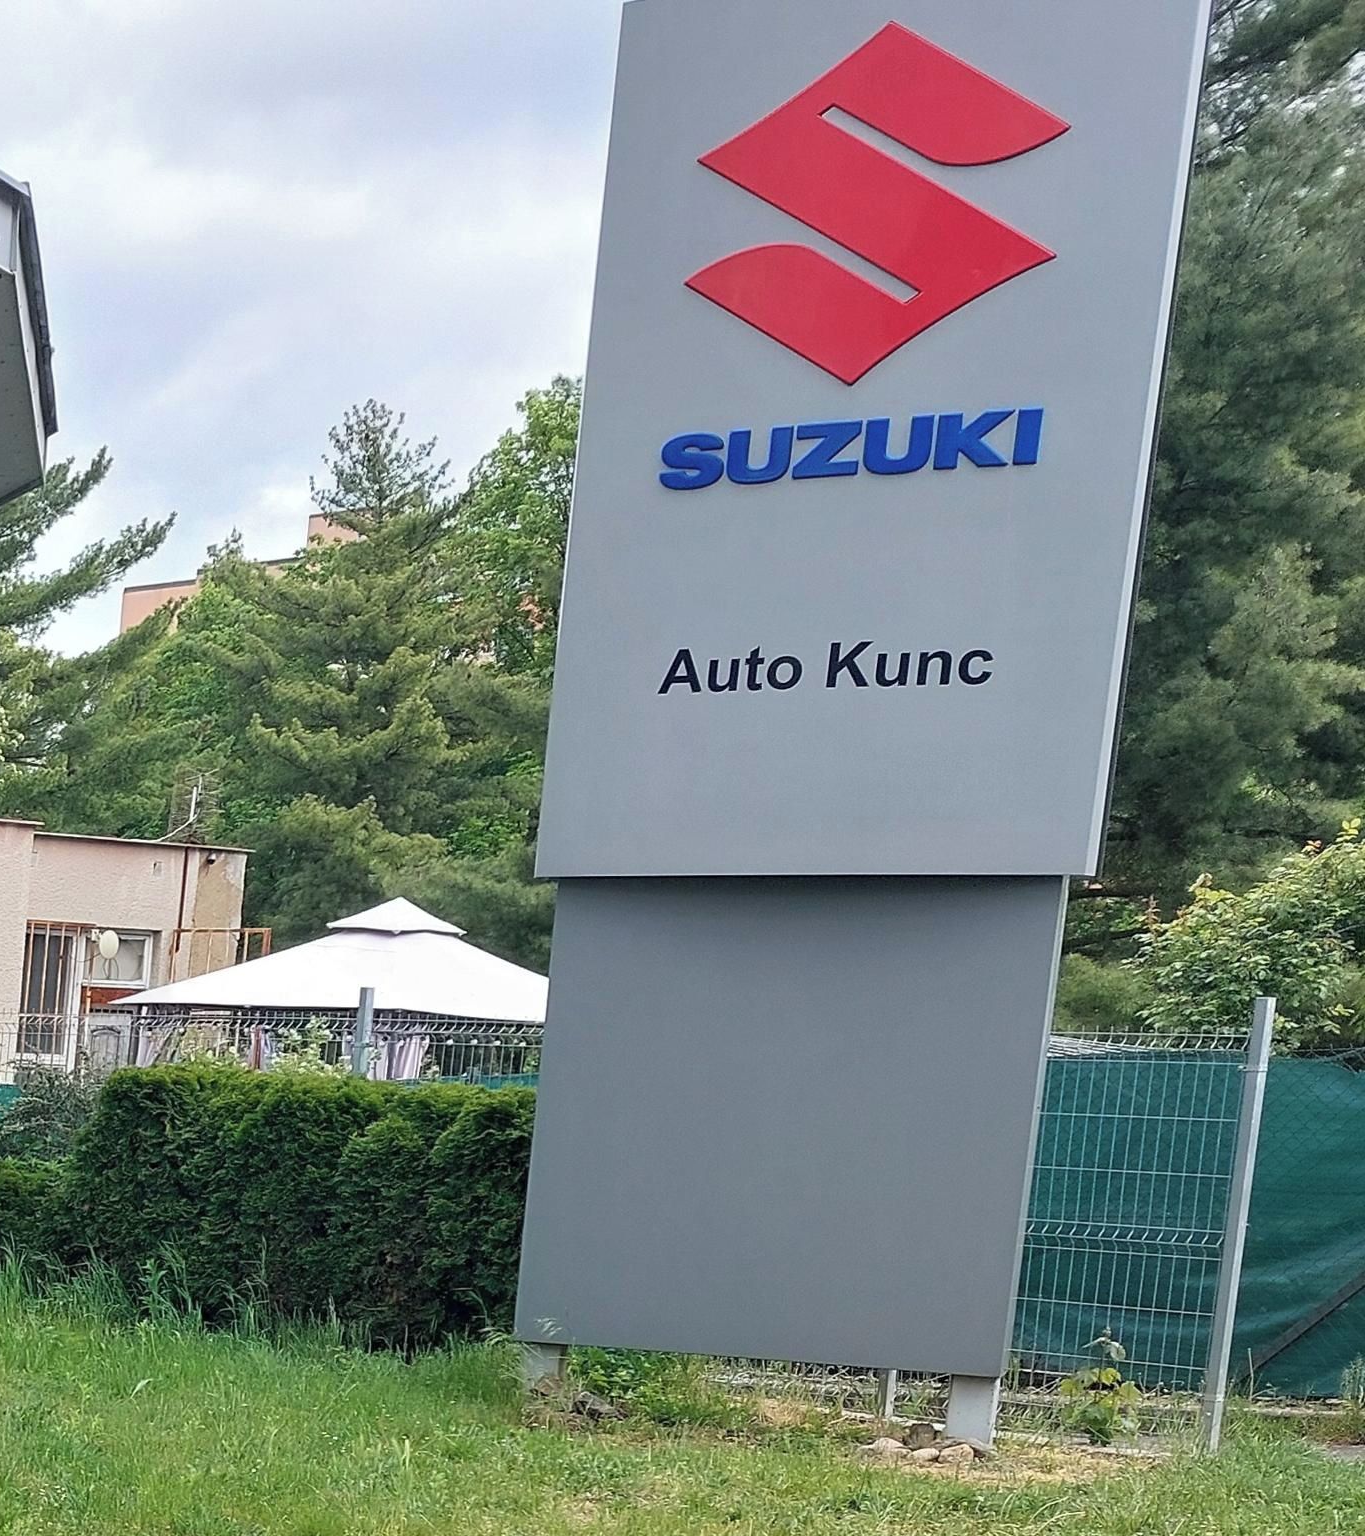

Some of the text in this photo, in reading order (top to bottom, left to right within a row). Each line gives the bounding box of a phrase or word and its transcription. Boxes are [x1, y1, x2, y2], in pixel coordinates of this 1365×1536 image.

[658, 406, 1044, 491] SUZUKI
[657, 640, 995, 696] Auto Kunc
